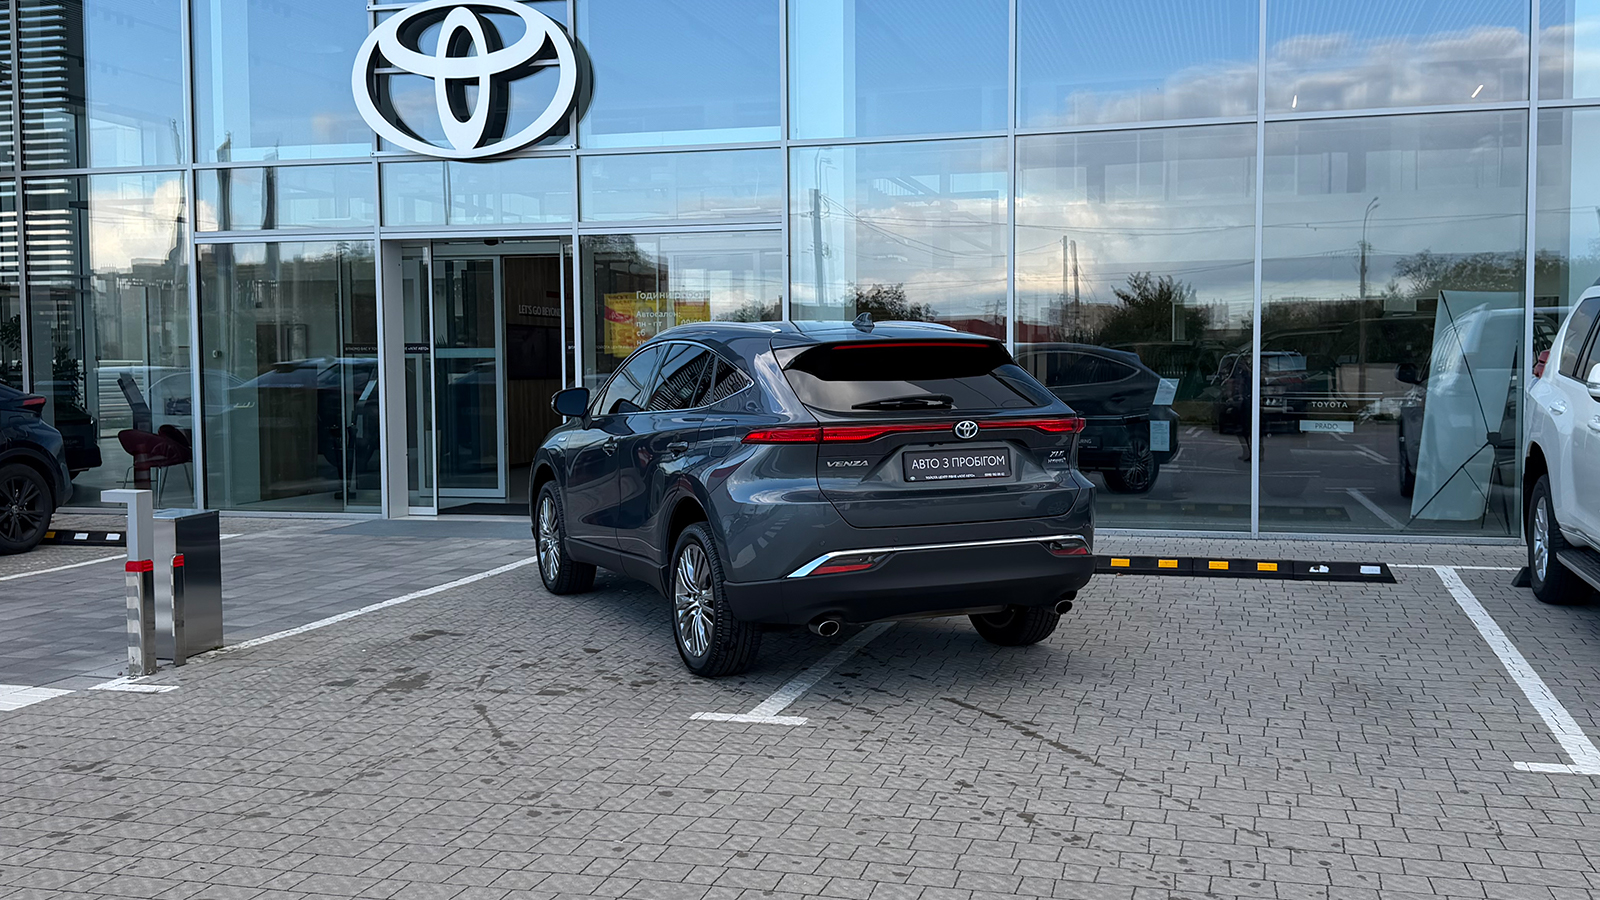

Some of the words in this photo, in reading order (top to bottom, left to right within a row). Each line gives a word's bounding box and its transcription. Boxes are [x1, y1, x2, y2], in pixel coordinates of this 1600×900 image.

[636, 290, 671, 301] Години
[518, 304, 532, 315] LET'S
[532, 305, 542, 316] GO
[636, 310, 681, 318] Автосалон:
[636, 328, 646, 337] сб
[1314, 422, 1339, 430] PRADO
[826, 459, 869, 468] VENZA
[911, 458, 940, 470] АВТО
[942, 457, 950, 469] З
[951, 455, 1006, 468] ПРОБІГОМ
